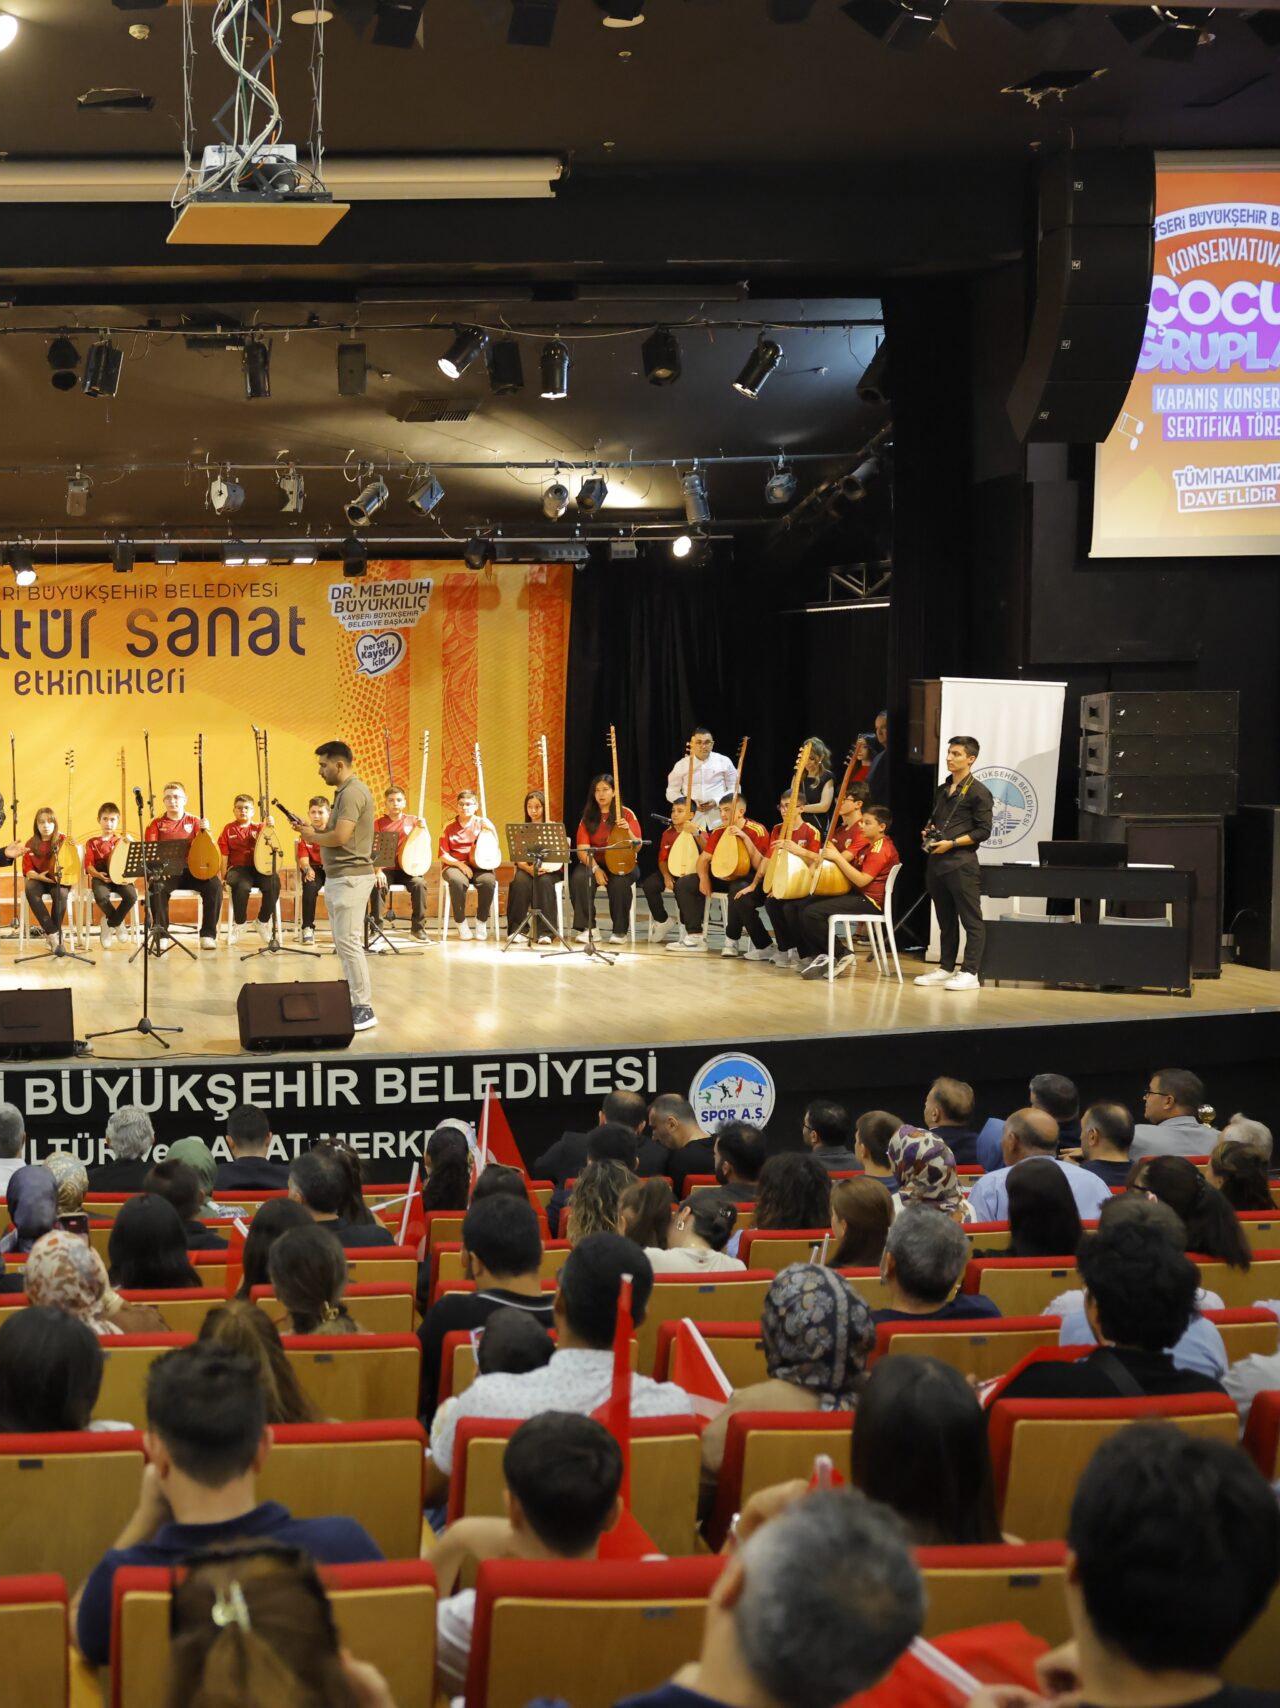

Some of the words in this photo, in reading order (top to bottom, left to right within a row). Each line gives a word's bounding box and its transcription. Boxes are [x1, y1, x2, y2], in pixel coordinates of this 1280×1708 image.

[1156, 388, 1218, 412] KAPANIŞ
[1224, 387, 1280, 409] KONSER
[1175, 468, 1208, 487] TÜM
[331, 586, 356, 600] DR.
[360, 581, 431, 598] MEMDUH
[334, 596, 428, 613] BÜYÜKKILIÇ
[361, 643, 395, 660] Kayseri
[976, 770, 1018, 783] YÜKŞEHİR
[985, 838, 1003, 846] 869
[24, 1062, 360, 1121] BÜYÜKŞEHİR
[375, 1051, 657, 1105] BELEDİYESİ
[701, 1108, 736, 1122] SPOR
[188, 1133, 308, 1162] AAT
